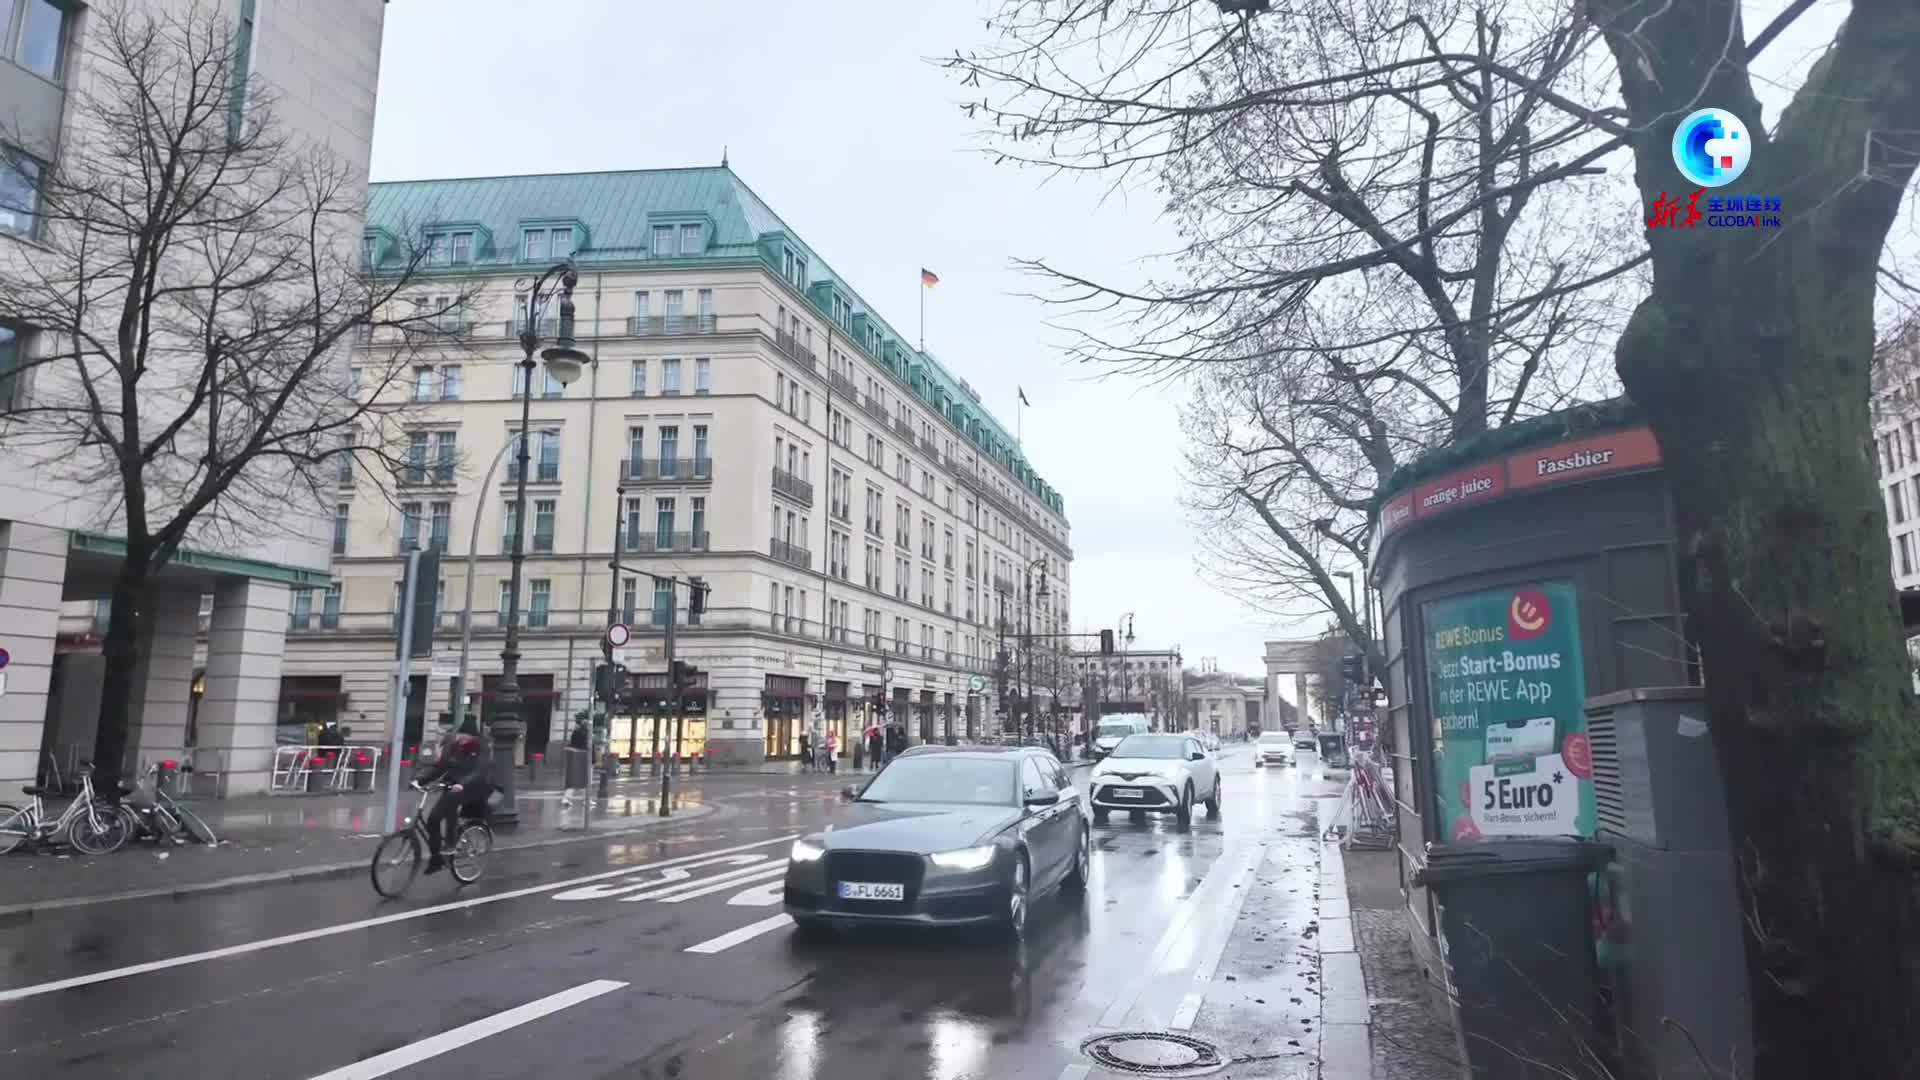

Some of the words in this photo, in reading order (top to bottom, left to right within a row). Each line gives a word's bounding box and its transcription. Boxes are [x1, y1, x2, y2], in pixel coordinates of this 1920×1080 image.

[1537, 448, 1613, 476] Fassbier
[1423, 485, 1458, 507] orange
[1460, 476, 1492, 498] juice
[1464, 626, 1504, 646] Bonus
[1460, 651, 1561, 675] Start-Bonus
[1449, 684, 1464, 704] der
[1467, 680, 1511, 702] REWE
[1517, 679, 1552, 703] App
[1442, 708, 1479, 729] sichern!
